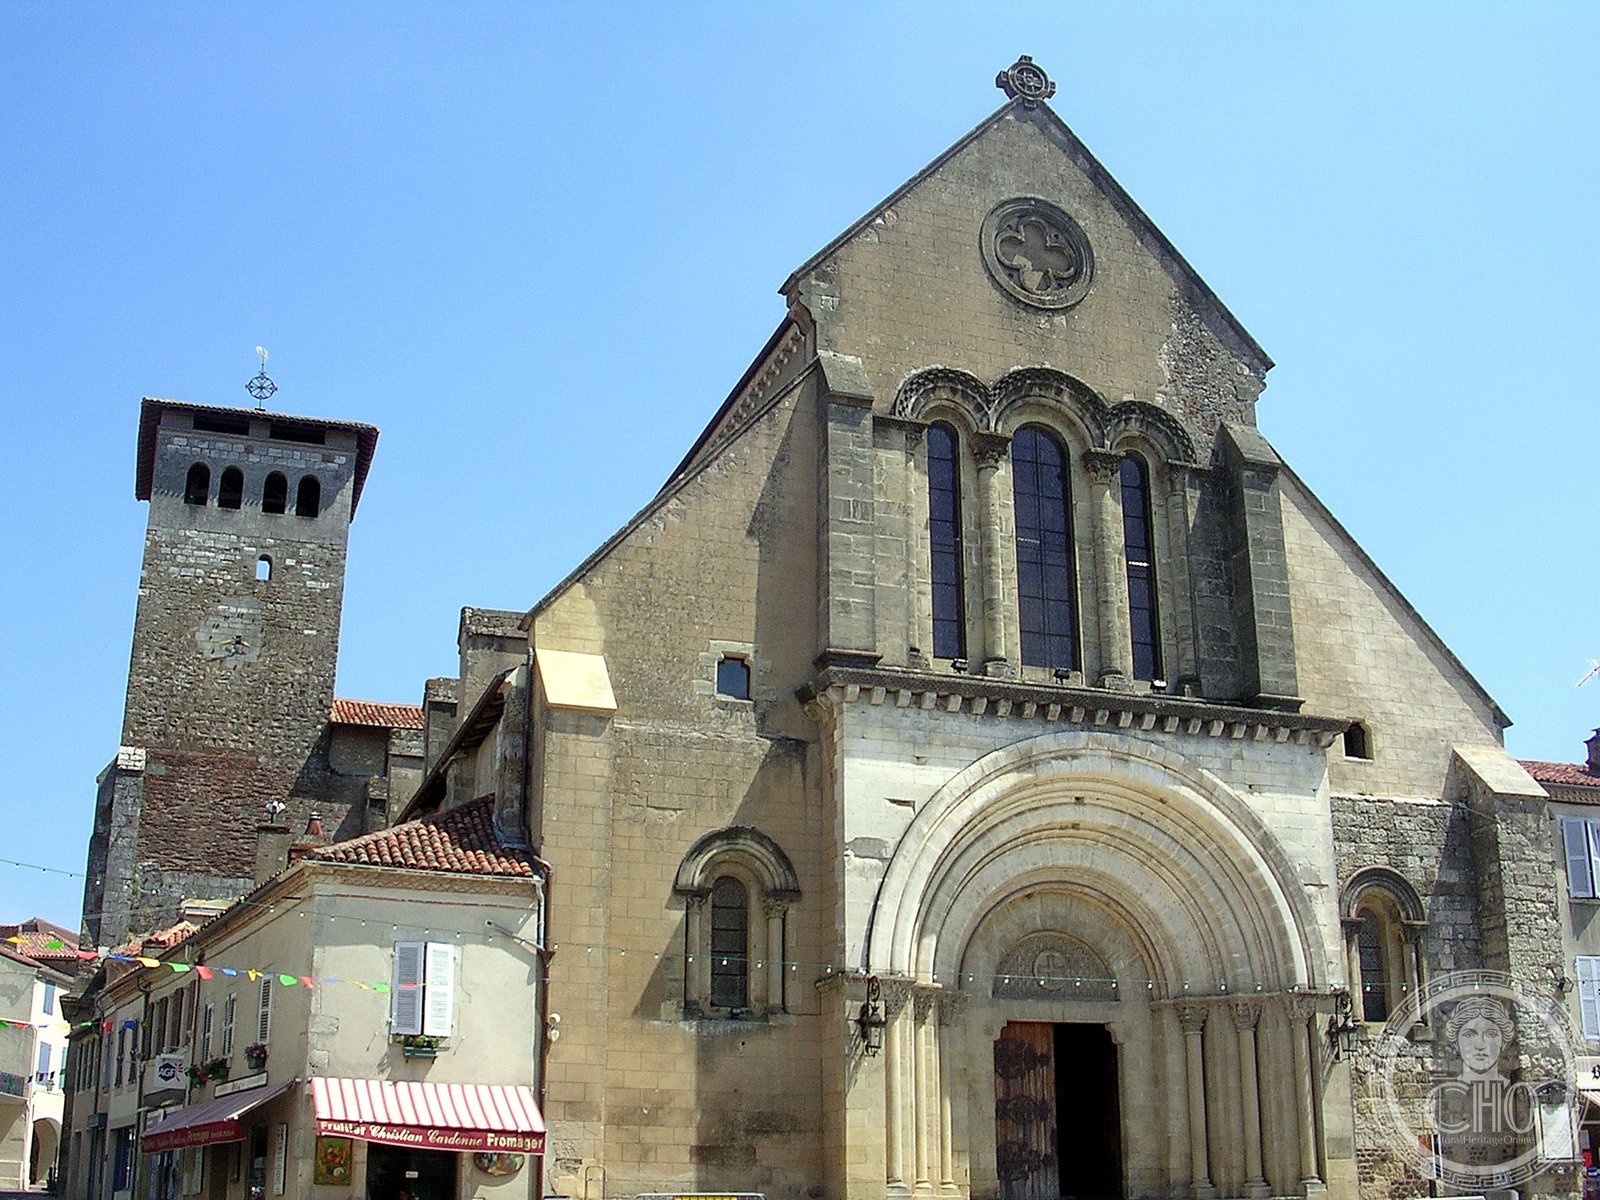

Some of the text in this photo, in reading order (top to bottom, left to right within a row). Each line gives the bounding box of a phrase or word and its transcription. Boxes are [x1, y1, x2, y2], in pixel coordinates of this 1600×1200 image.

[369, 1124, 424, 1143] Christian
[427, 1126, 482, 1147] Cardonne
[486, 1132, 544, 1150] Fromager
